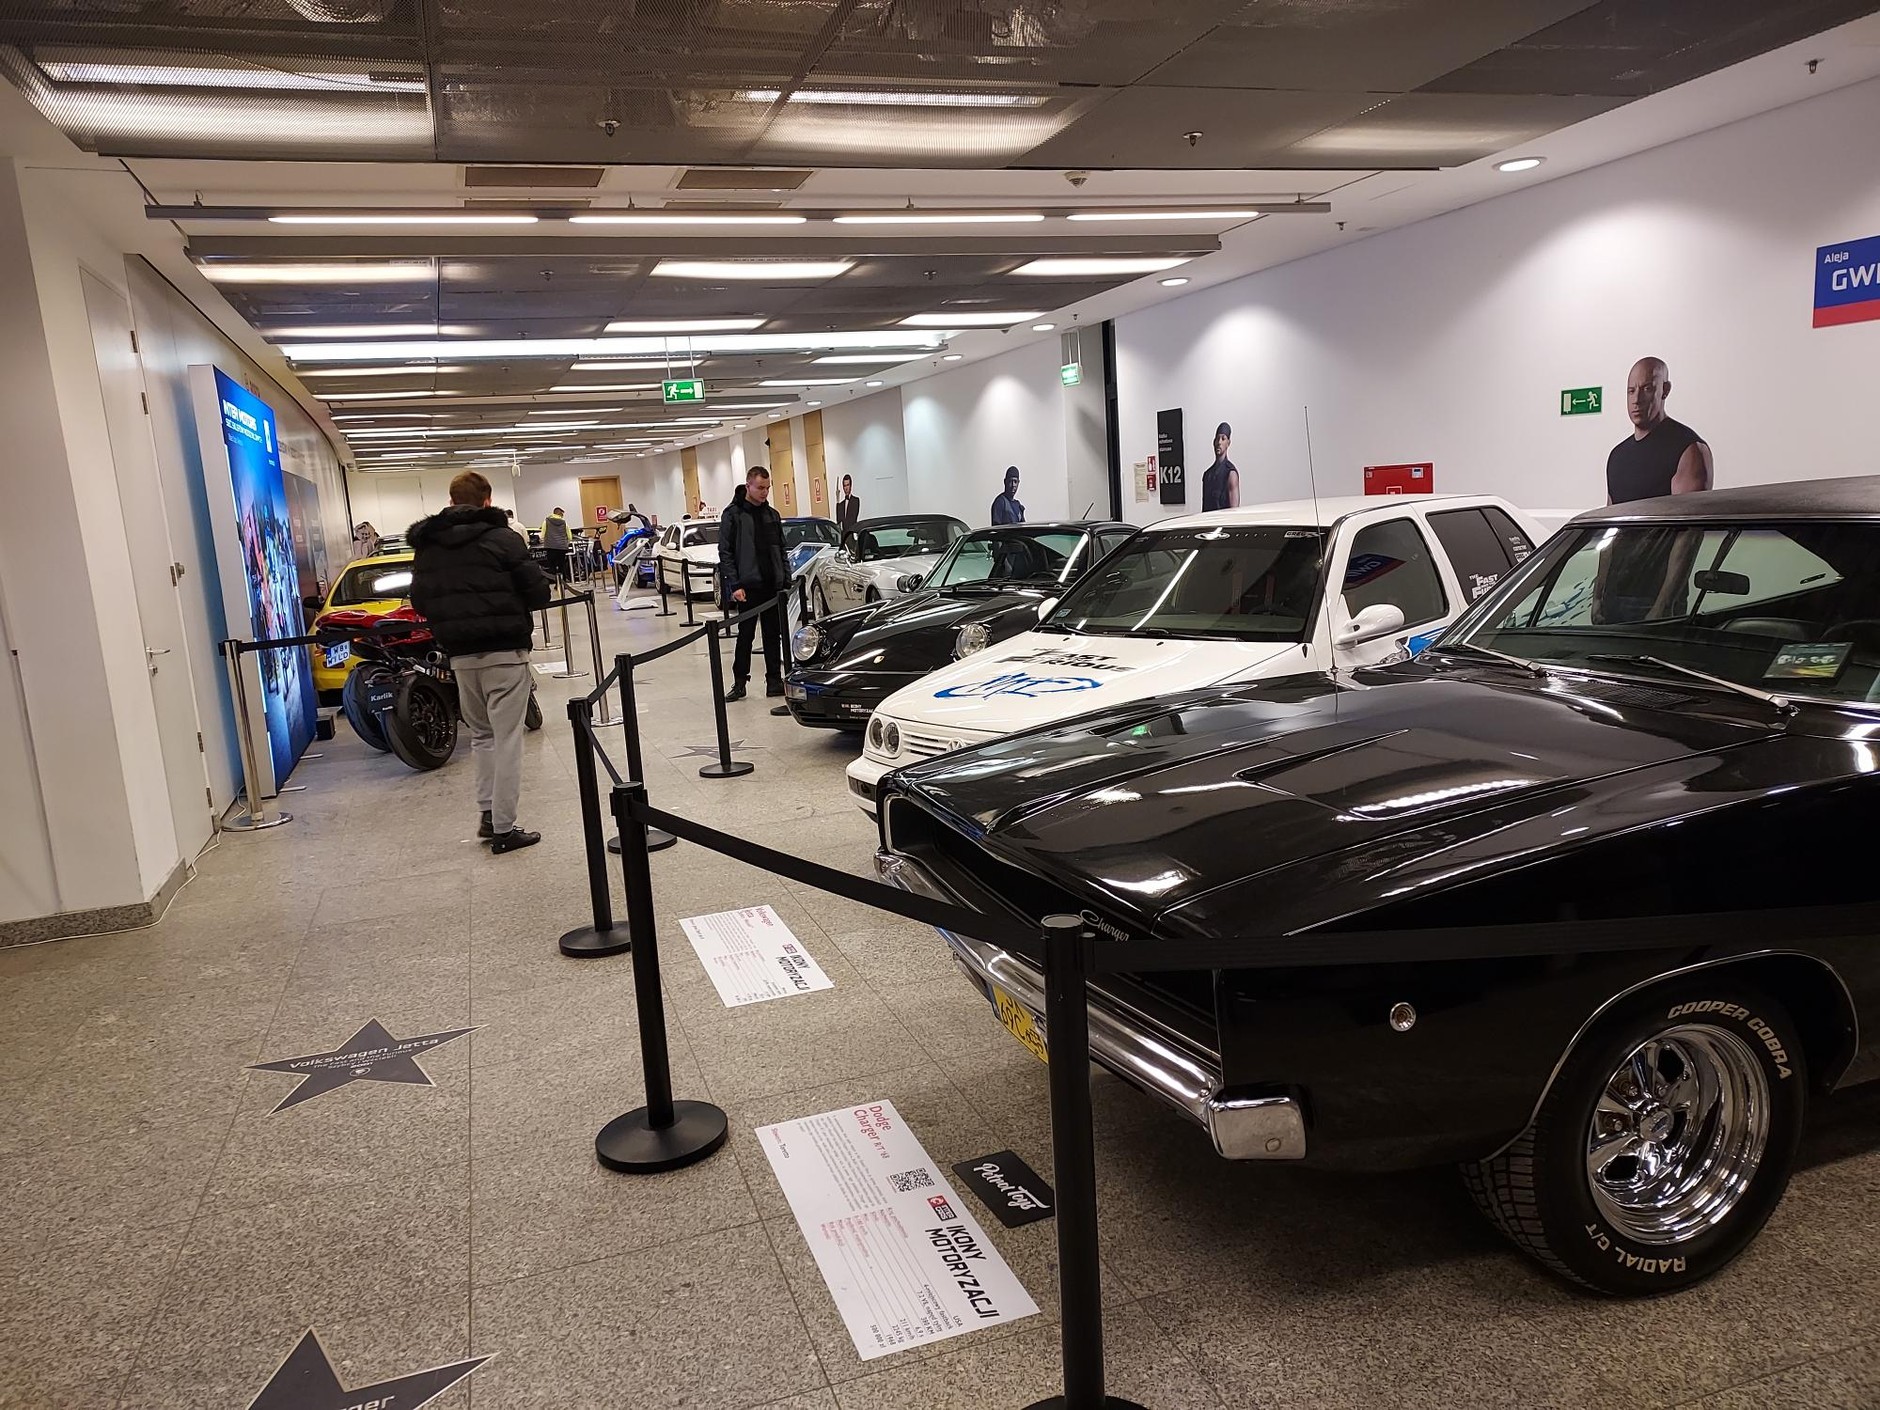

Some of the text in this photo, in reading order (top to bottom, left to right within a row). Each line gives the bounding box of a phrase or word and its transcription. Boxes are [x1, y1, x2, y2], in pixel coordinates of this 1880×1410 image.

[1824, 251, 1849, 263] Aleja
[1160, 466, 1181, 484] K12
[1476, 574, 1498, 586] FAST
[327, 650, 349, 666] WILD
[370, 692, 393, 702] Karlik
[1080, 909, 1130, 942] Charger
[1667, 1000, 1792, 1079] COOPER COBRA
[289, 1038, 440, 1069] Volkswagen Jetta
[854, 1110, 880, 1140] Charger
[869, 1106, 891, 1130] Dodge
[1007, 1186, 1051, 1211] Toys
[946, 1225, 986, 1260] IKONY
[1585, 1224, 1686, 1273] RADIAL G/T
[925, 1228, 1000, 1318] MOTORYZACJI
[953, 1316, 963, 1327] USA
